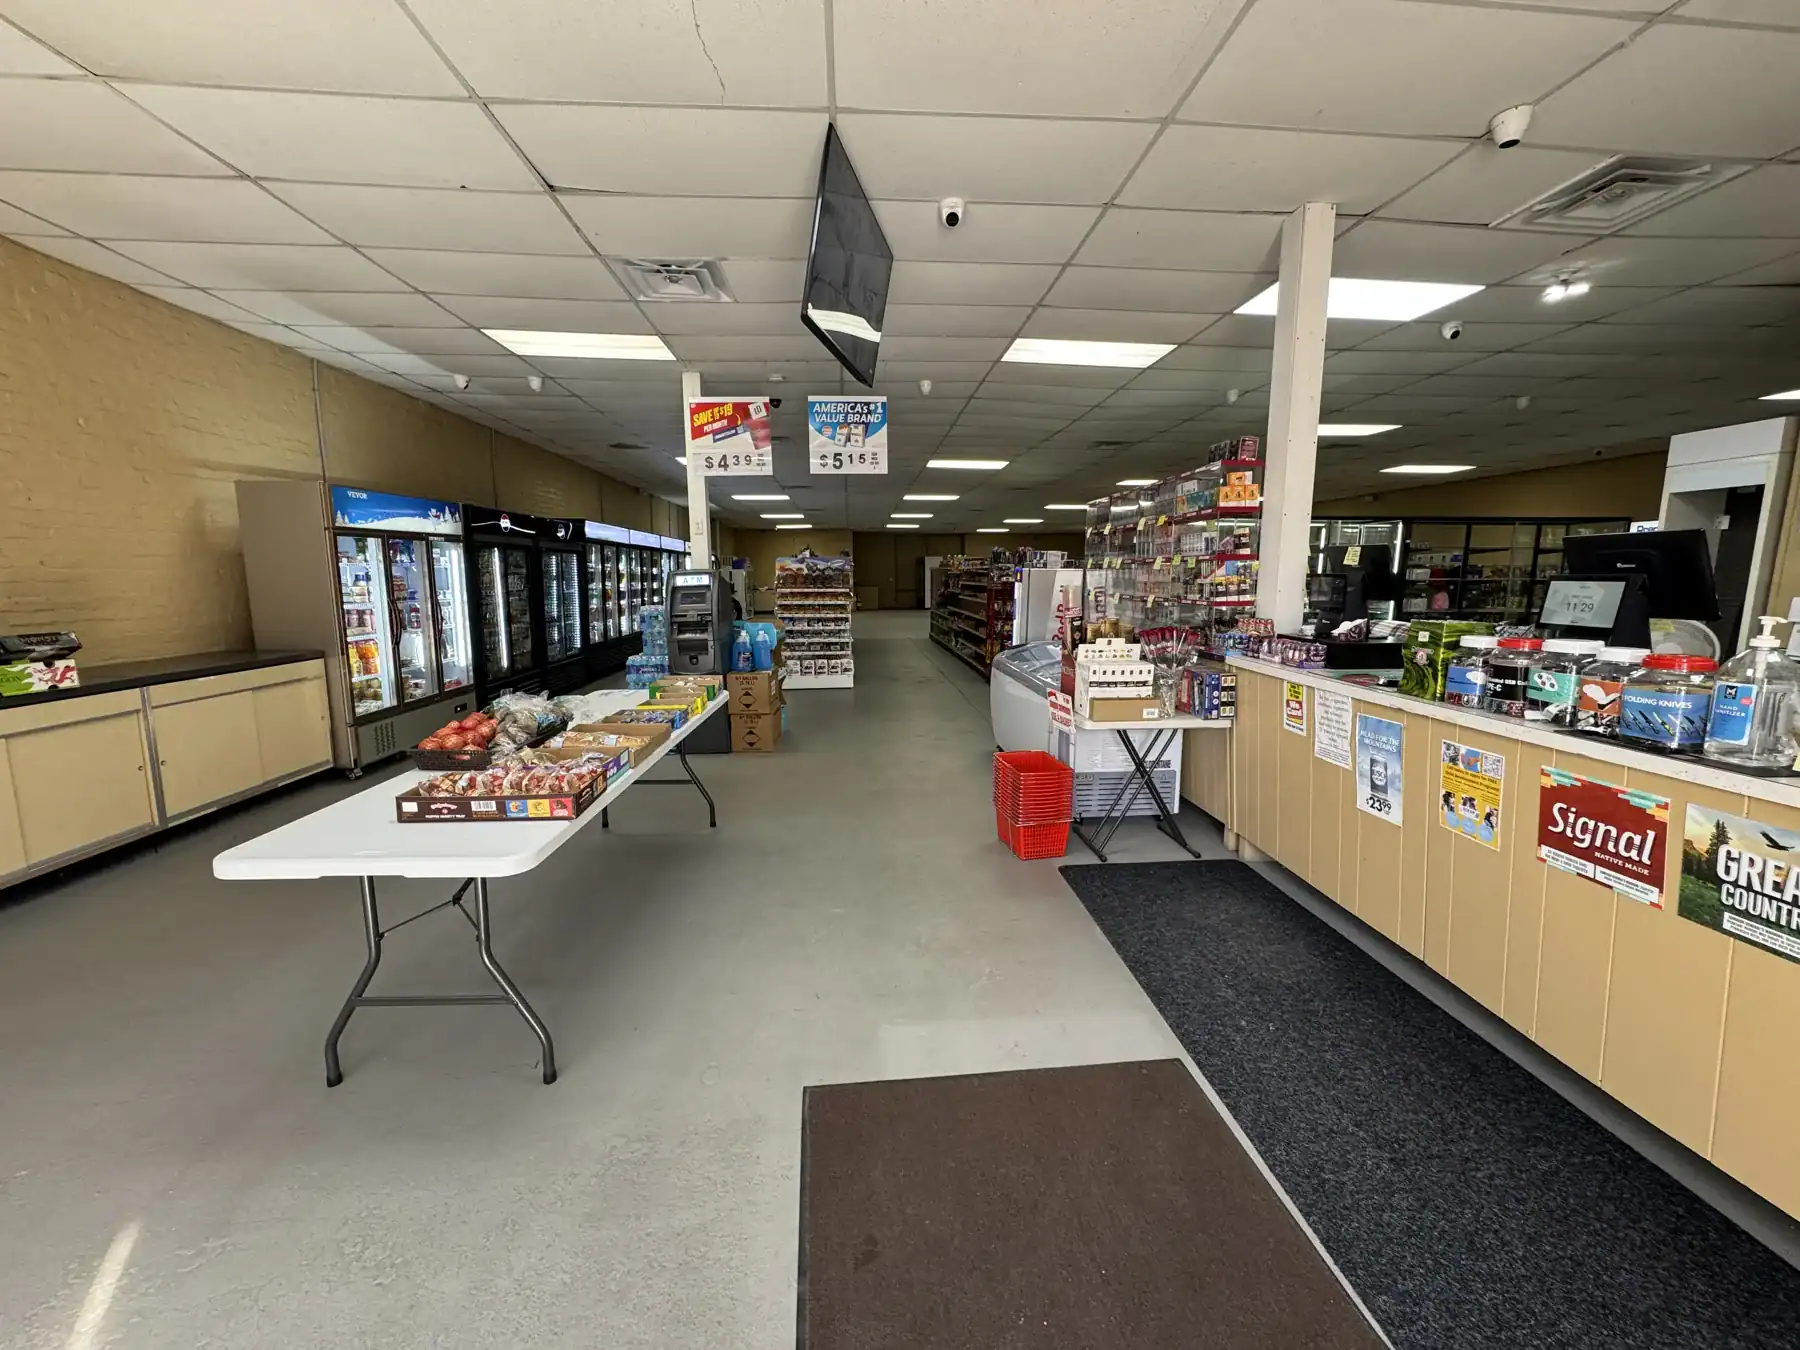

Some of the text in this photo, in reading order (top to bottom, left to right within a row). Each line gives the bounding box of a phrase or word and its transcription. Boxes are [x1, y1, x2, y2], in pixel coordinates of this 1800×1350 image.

[813, 402, 883, 413] AMERICA's #1
[693, 408, 713, 427] SAVE
[815, 414, 881, 423] VALUE BRAND
[683, 575, 703, 583] ATM
[1288, 700, 1300, 709] We
[1658, 699, 1692, 709] KNIVES
[1287, 707, 1302, 717] Card
[1360, 730, 1400, 746] HEAD FOR THE
[1364, 738, 1397, 753] MOUNTAINS
[1548, 802, 1656, 865] Signal
[1594, 851, 1624, 866] NATIVE
[1625, 862, 1650, 876] MADE
